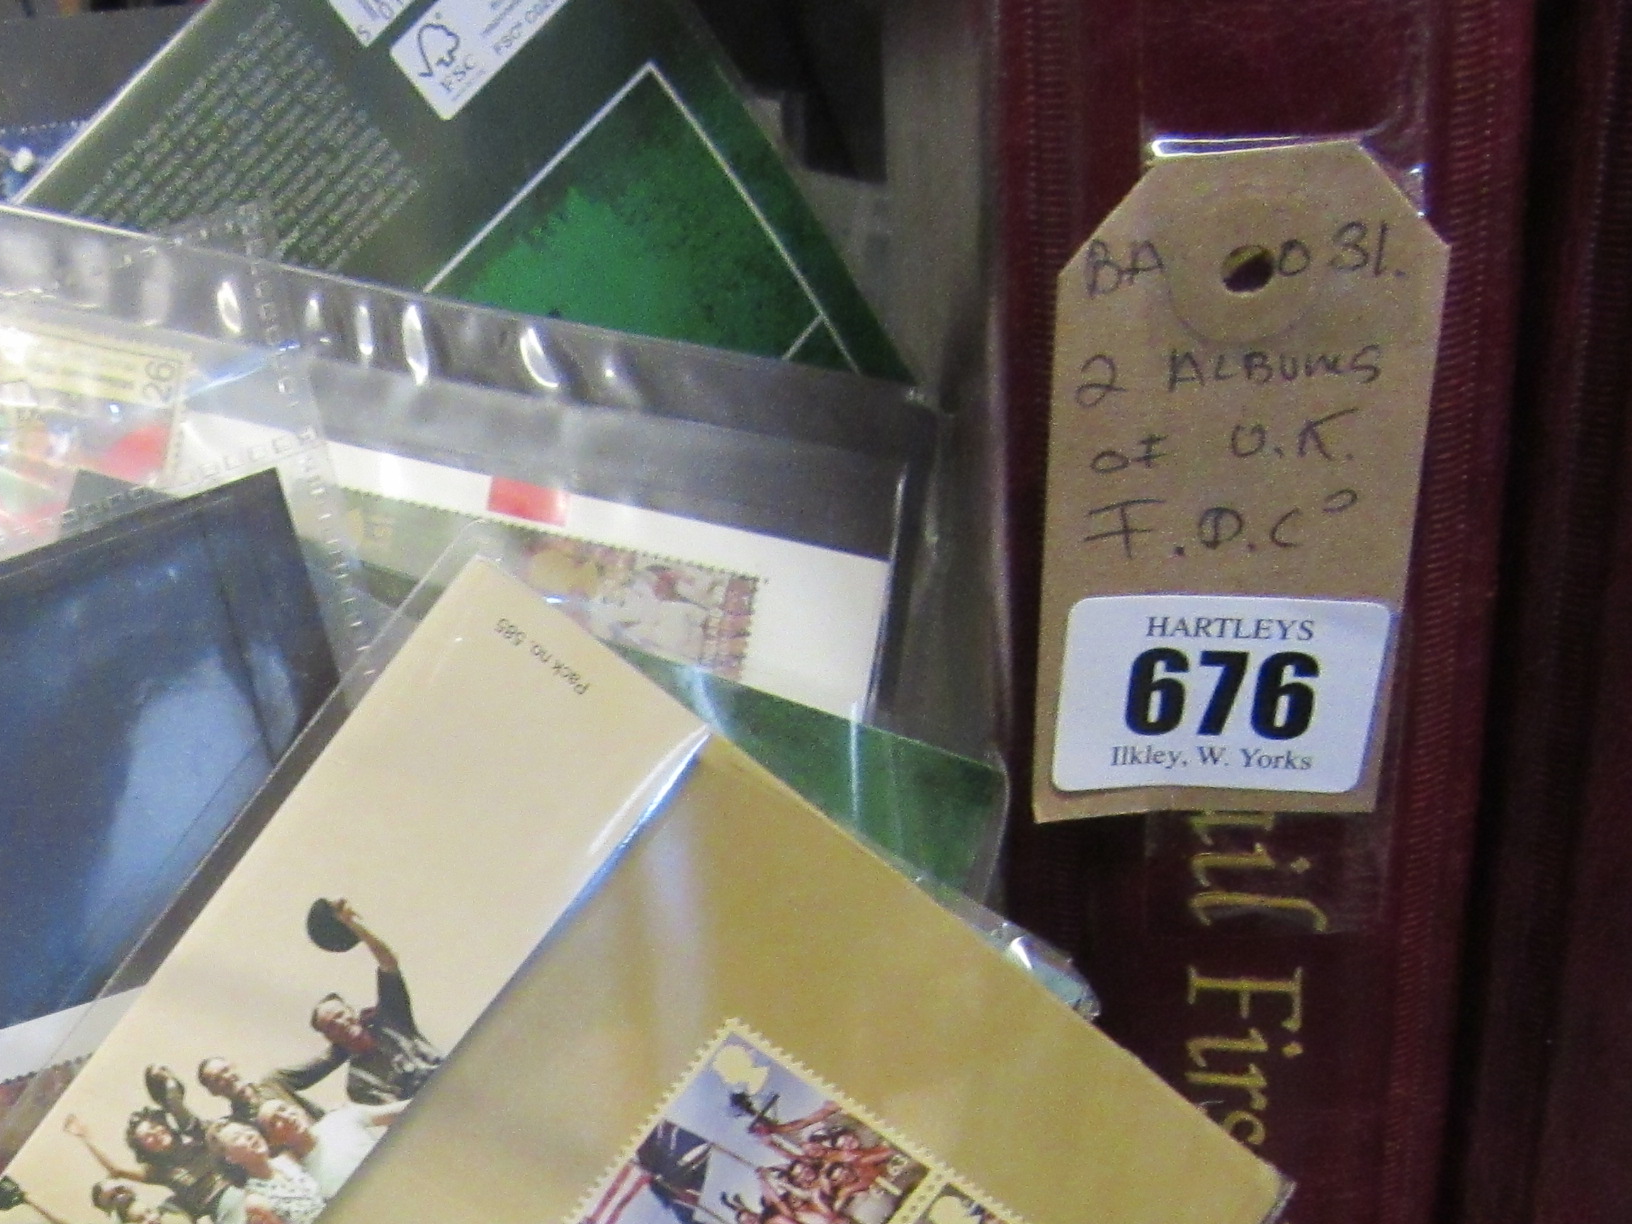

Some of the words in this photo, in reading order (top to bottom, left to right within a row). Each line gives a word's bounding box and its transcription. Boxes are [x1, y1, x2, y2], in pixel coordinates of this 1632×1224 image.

[1084, 239, 1165, 298] BA
[1076, 354, 1125, 407] 2
[1167, 343, 1382, 393] ALBUMS
[1145, 615, 1315, 642] HARTLEYS
[529, 640, 552, 663] no.
[552, 659, 590, 695] Pack
[1124, 647, 1320, 741] 676
[1110, 745, 1189, 772] Ilkley,
[1199, 746, 1229, 767] W.
[1239, 746, 1313, 771] Yorks
